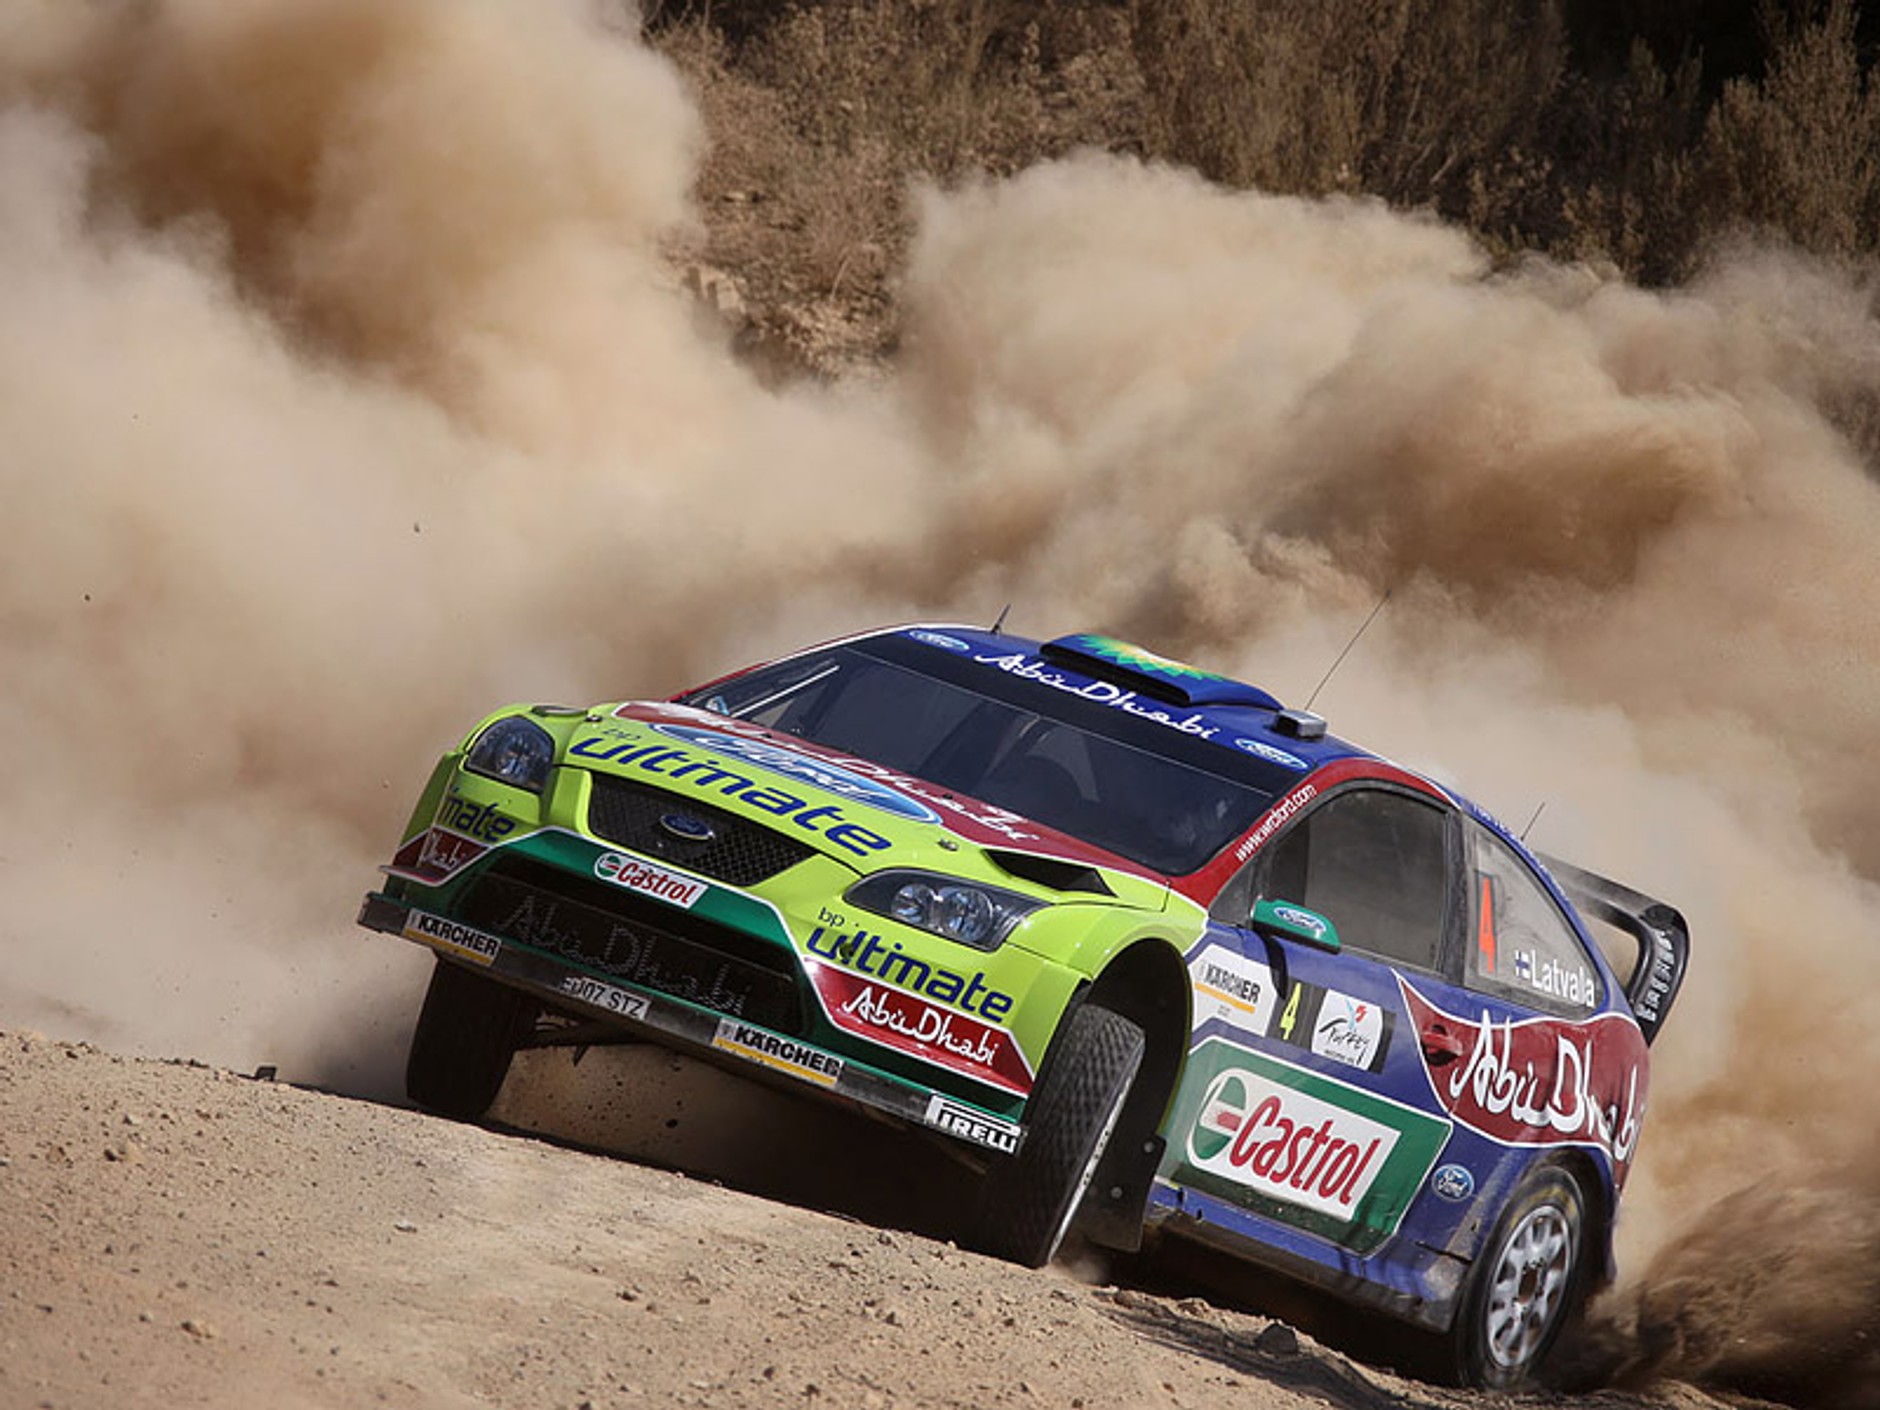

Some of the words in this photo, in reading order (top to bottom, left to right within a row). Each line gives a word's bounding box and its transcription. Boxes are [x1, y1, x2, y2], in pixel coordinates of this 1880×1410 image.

[1075, 681, 1221, 739] Dhabi
[568, 737, 893, 857] ultimate
[695, 736, 890, 799] Ford
[617, 862, 698, 904] Castrol
[818, 906, 845, 927] bp
[1477, 876, 1496, 974] 4
[806, 924, 1013, 1022] ultimate
[1531, 949, 1596, 1008] Latvala
[607, 991, 644, 1017] STZ
[1279, 982, 1302, 1040] 4
[914, 1008, 1000, 1068] Dhabi
[923, 1095, 1021, 1154] PIRELLI
[1228, 1094, 1382, 1205] Castrol
